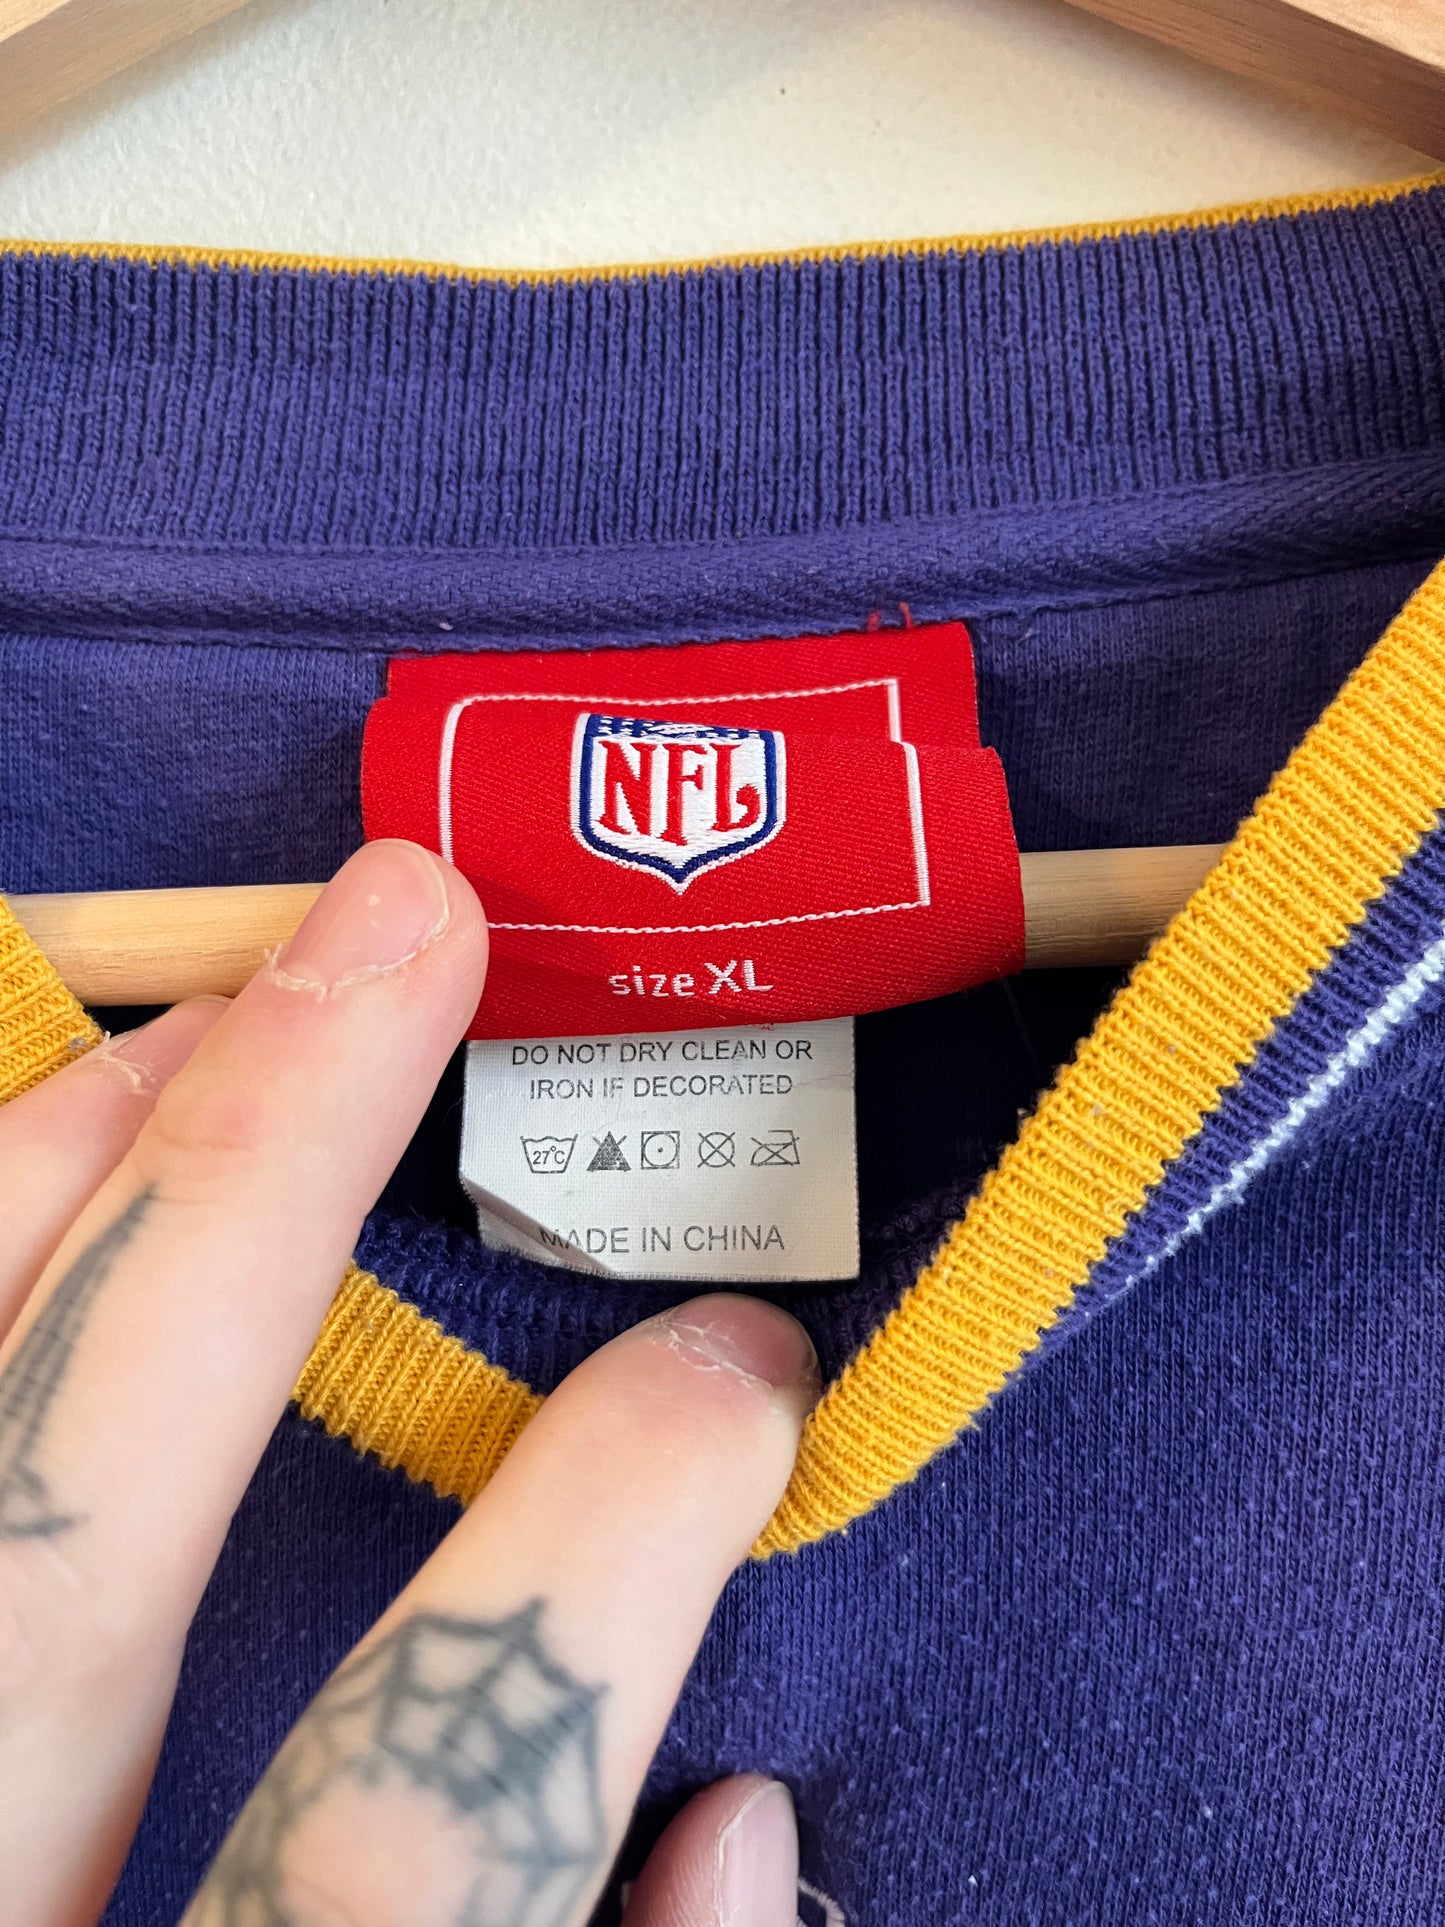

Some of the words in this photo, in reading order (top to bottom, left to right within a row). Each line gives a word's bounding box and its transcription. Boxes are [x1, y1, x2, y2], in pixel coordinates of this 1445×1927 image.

[597, 741, 761, 846] NFL
[608, 965, 695, 997] size
[704, 960, 774, 995] XL
[511, 1045, 548, 1066] DO
[557, 1043, 612, 1064] NOT
[620, 1041, 673, 1063] DRY
[681, 1040, 767, 1062] CLEAN
[775, 1039, 813, 1060] OR
[529, 1078, 594, 1100] IRON
[603, 1077, 625, 1099] IF
[633, 1074, 794, 1097] DECORATED
[539, 1226, 630, 1255] MADE
[641, 1227, 672, 1252] IN
[683, 1225, 785, 1252] CHINA
